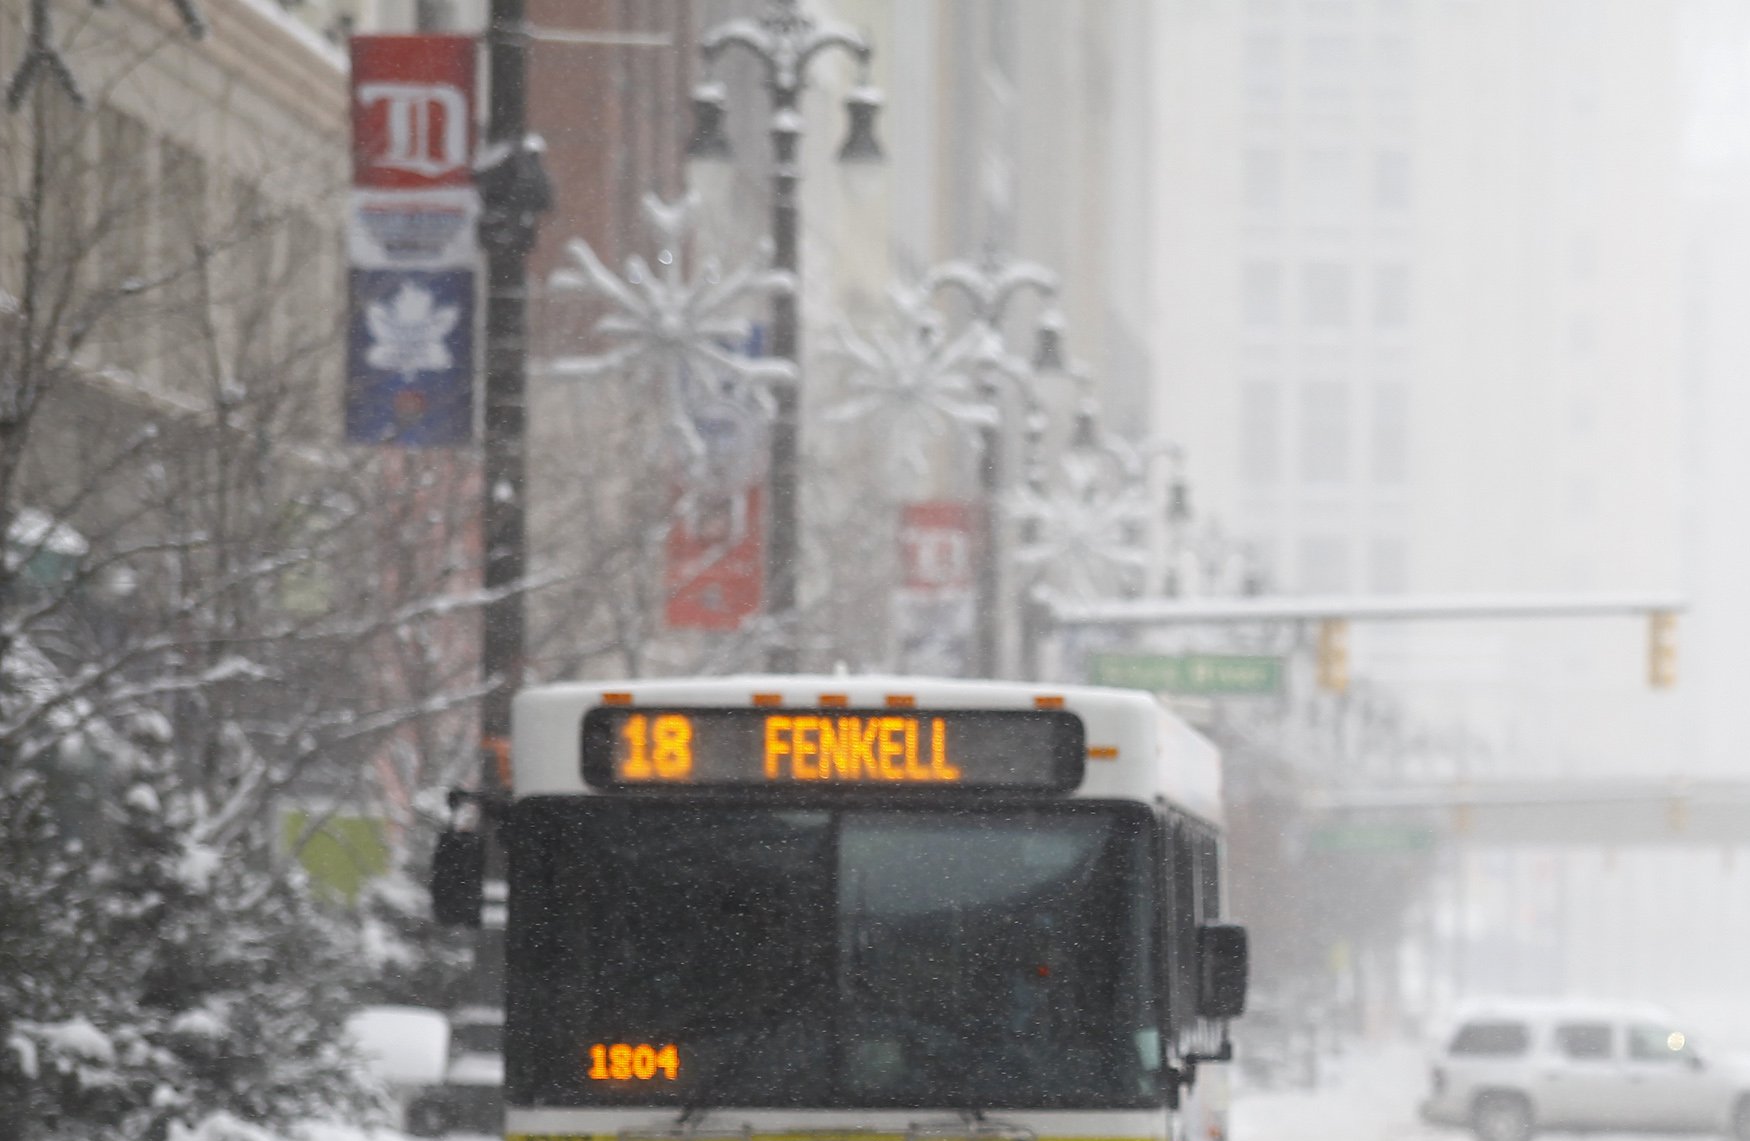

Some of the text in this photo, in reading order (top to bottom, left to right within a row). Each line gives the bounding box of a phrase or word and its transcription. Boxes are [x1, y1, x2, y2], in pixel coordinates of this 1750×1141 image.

[621, 713, 962, 782] 18 FENKELL
[587, 1043, 680, 1080] 1804
